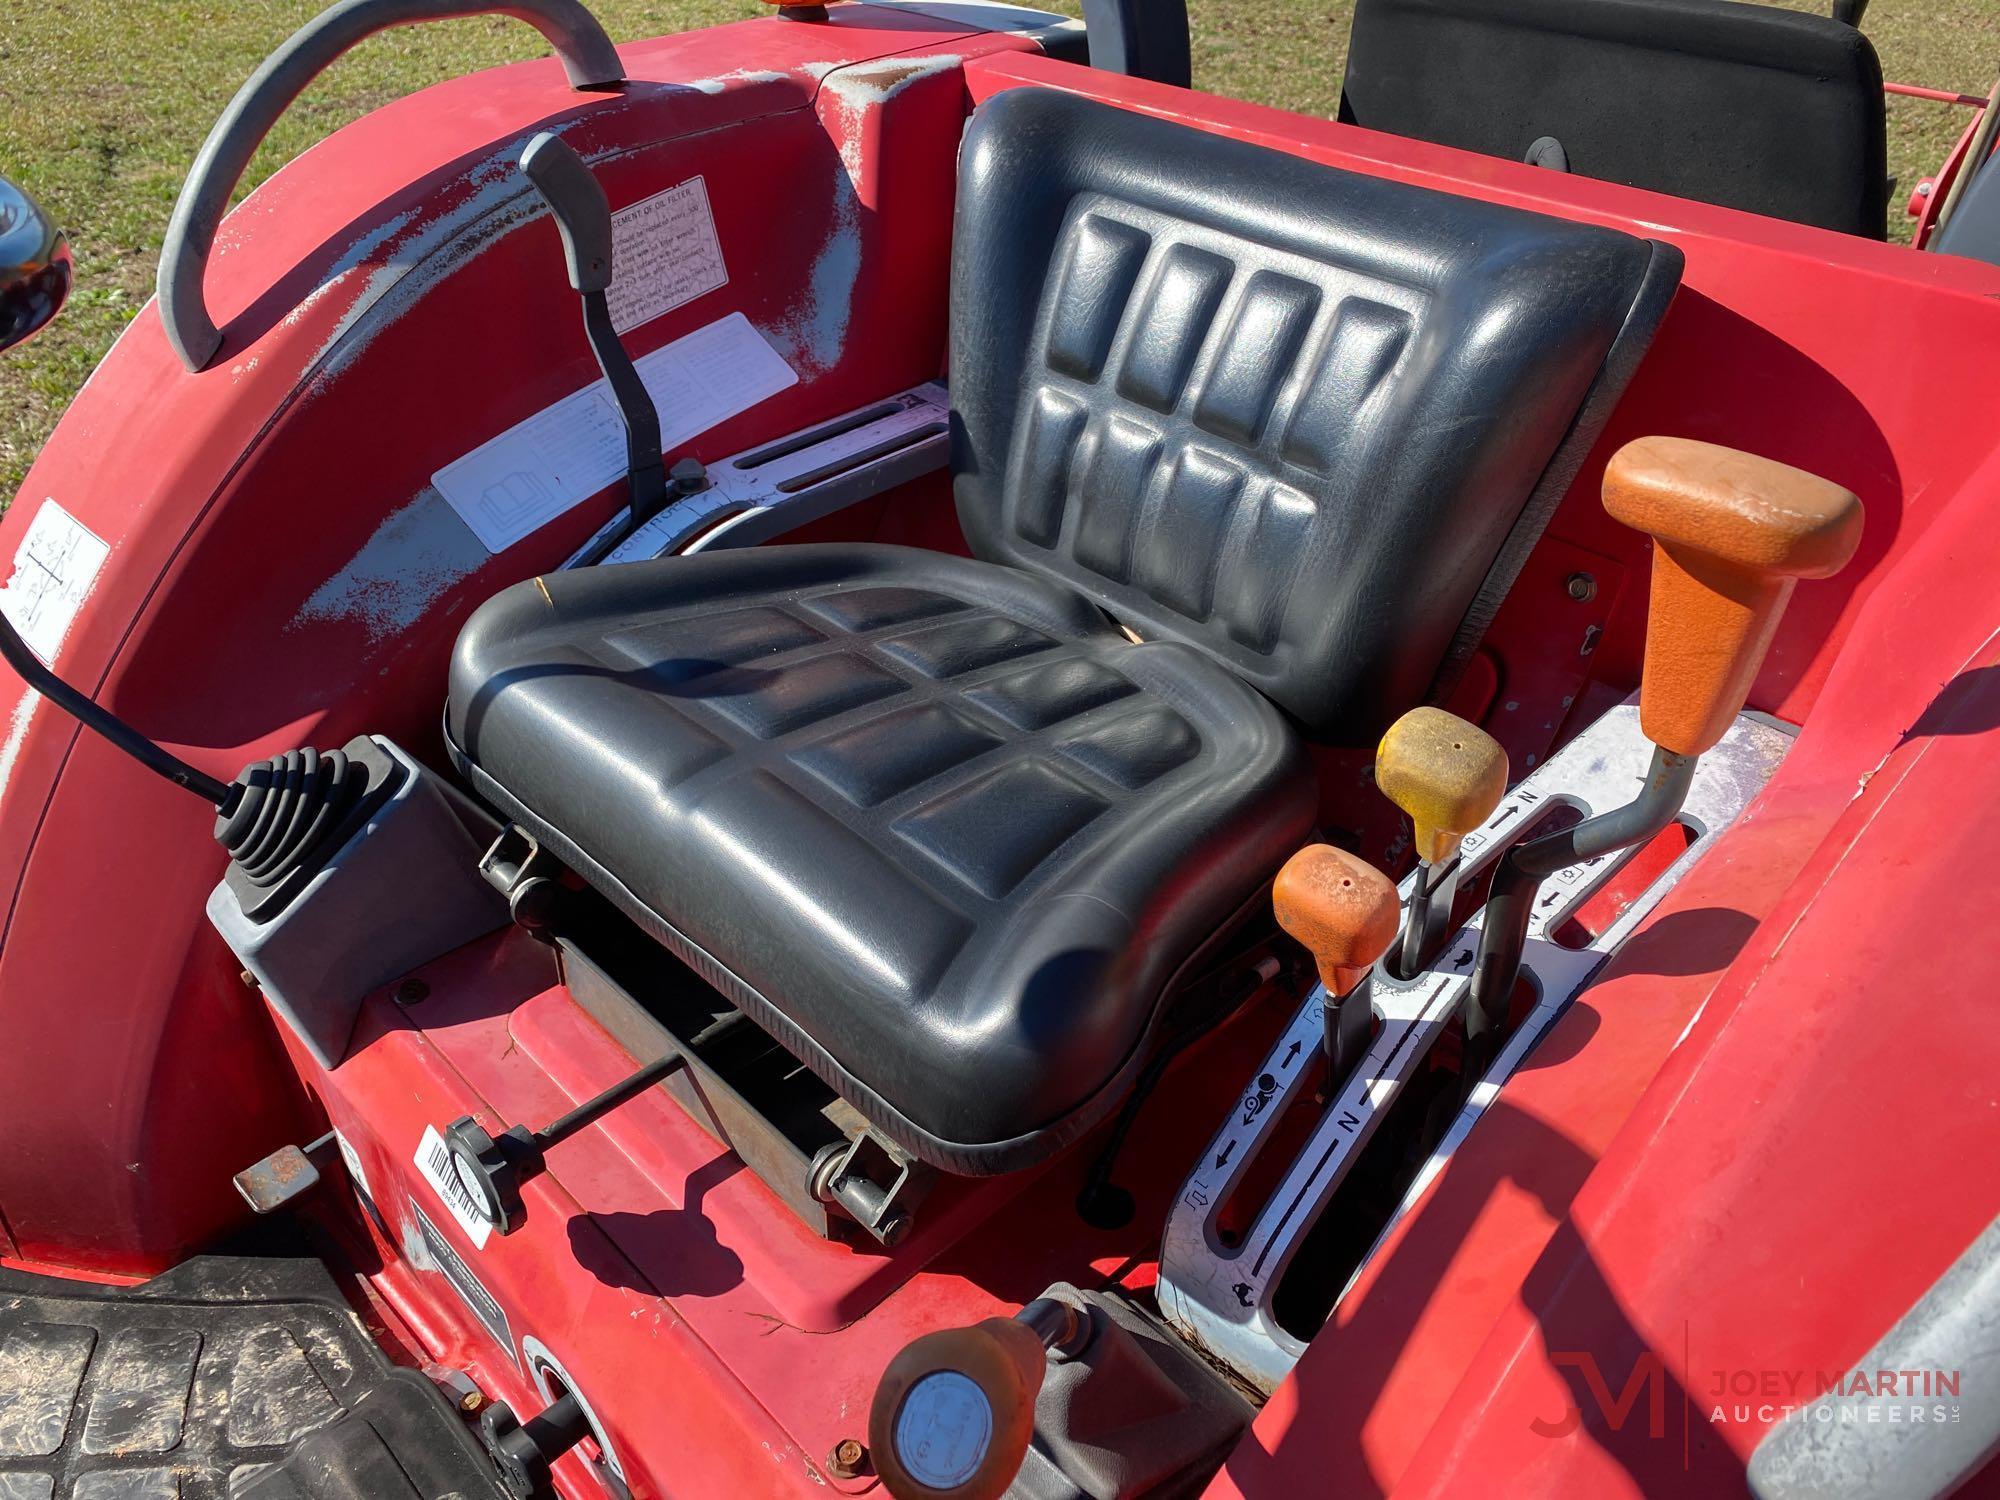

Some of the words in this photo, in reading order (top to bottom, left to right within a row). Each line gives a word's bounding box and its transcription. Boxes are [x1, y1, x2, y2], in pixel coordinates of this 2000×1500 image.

[612, 211, 642, 228] CEMENT
[643, 204, 652, 214] OF
[654, 199, 665, 209] OIL
[1517, 790, 1539, 804] N
[1337, 1111, 1361, 1134] N
